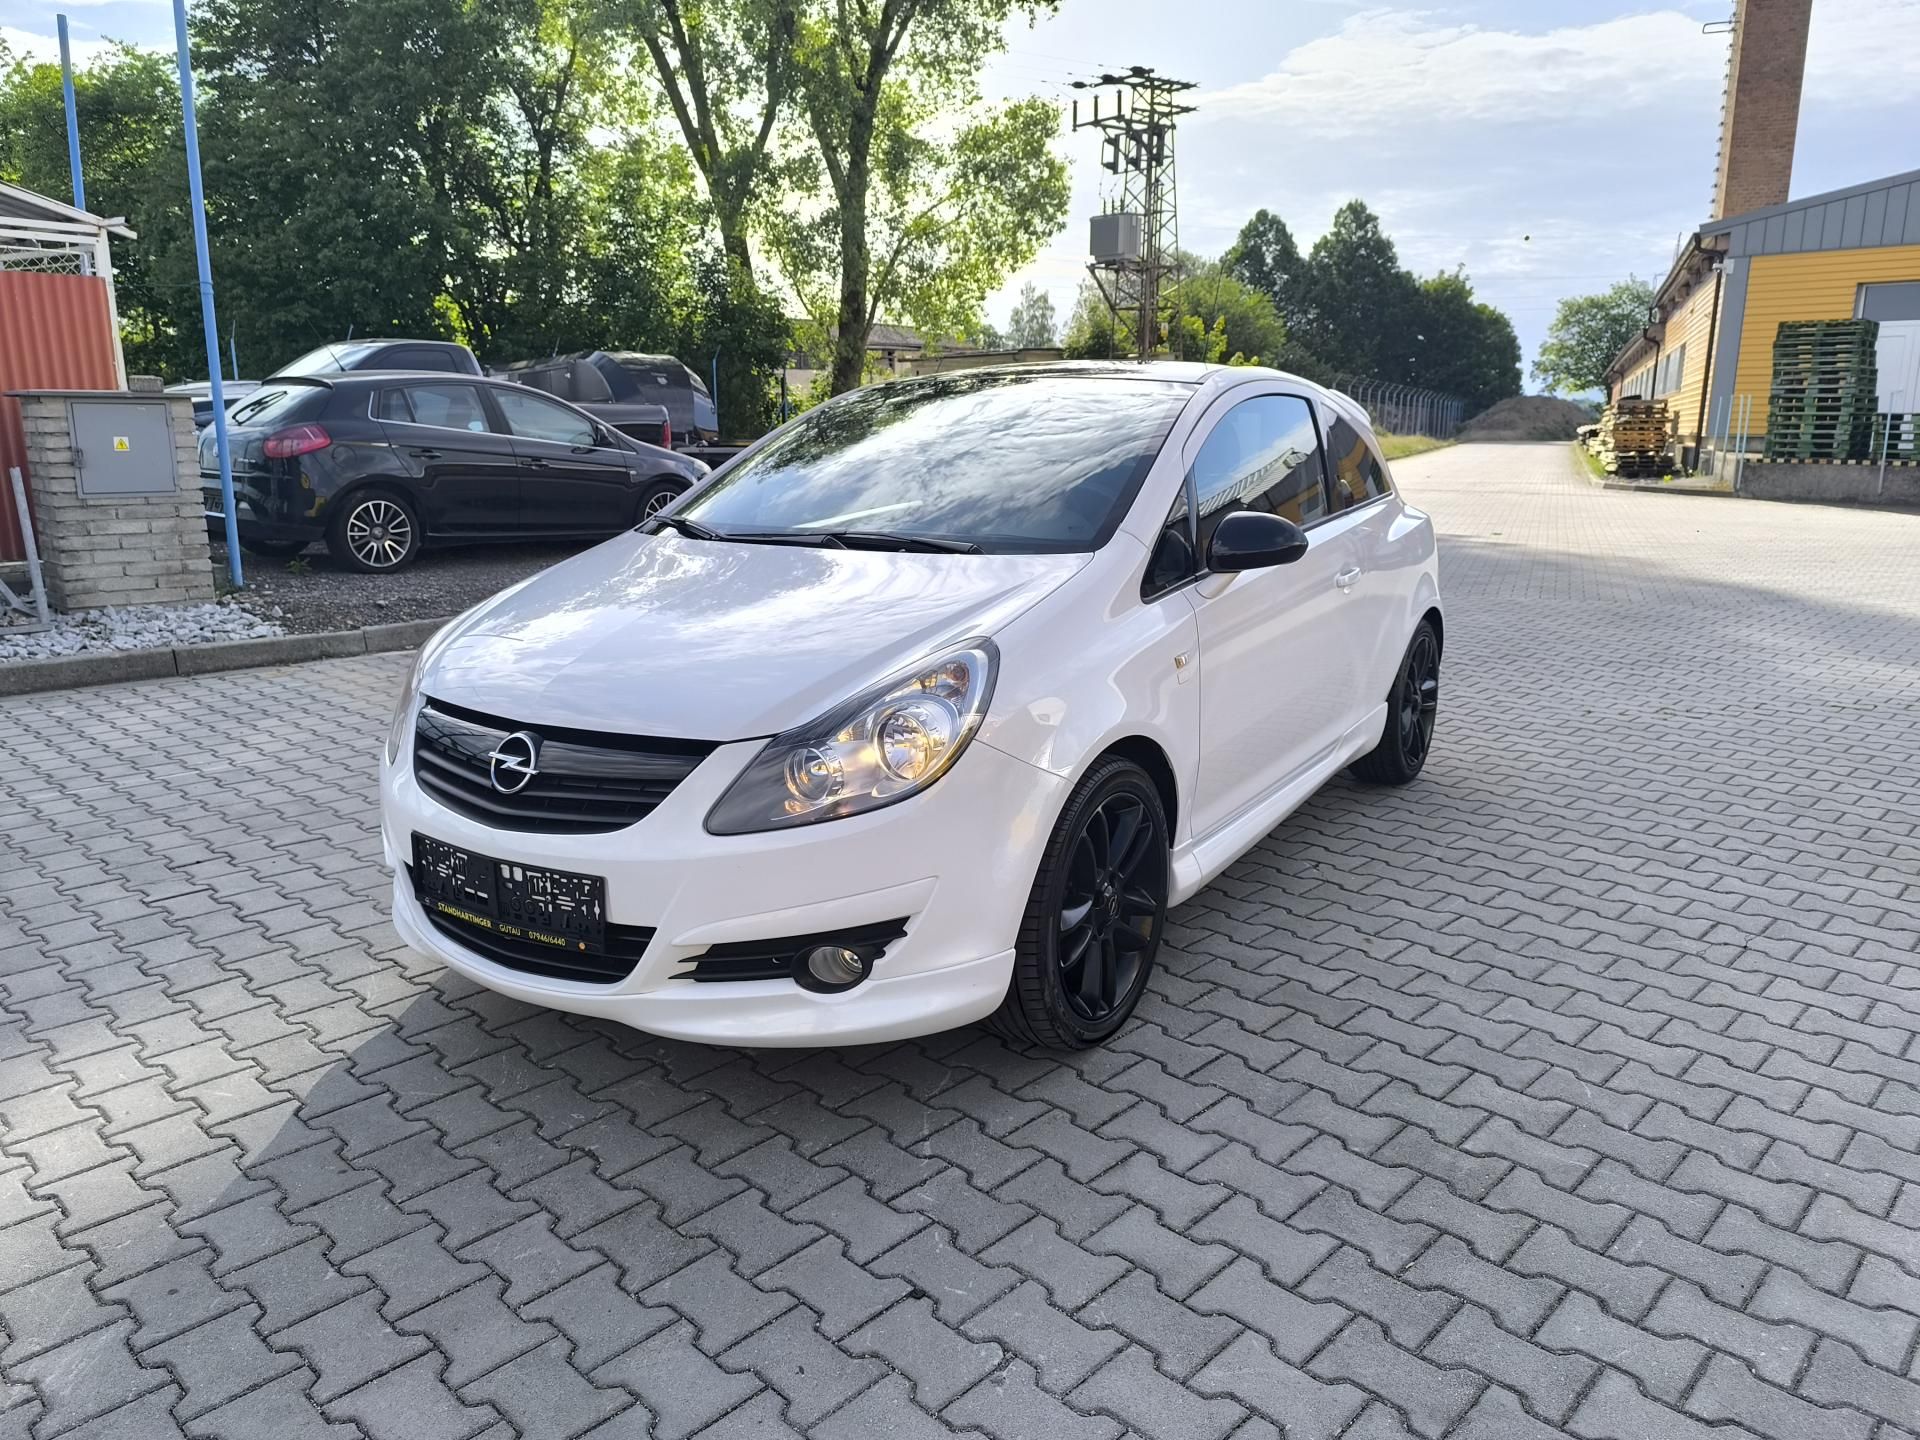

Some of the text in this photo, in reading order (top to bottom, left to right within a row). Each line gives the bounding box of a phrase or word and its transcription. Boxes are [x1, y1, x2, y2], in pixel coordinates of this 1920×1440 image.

[437, 902, 566, 946] STANDHARTINGER GUTAU 07946/6440
